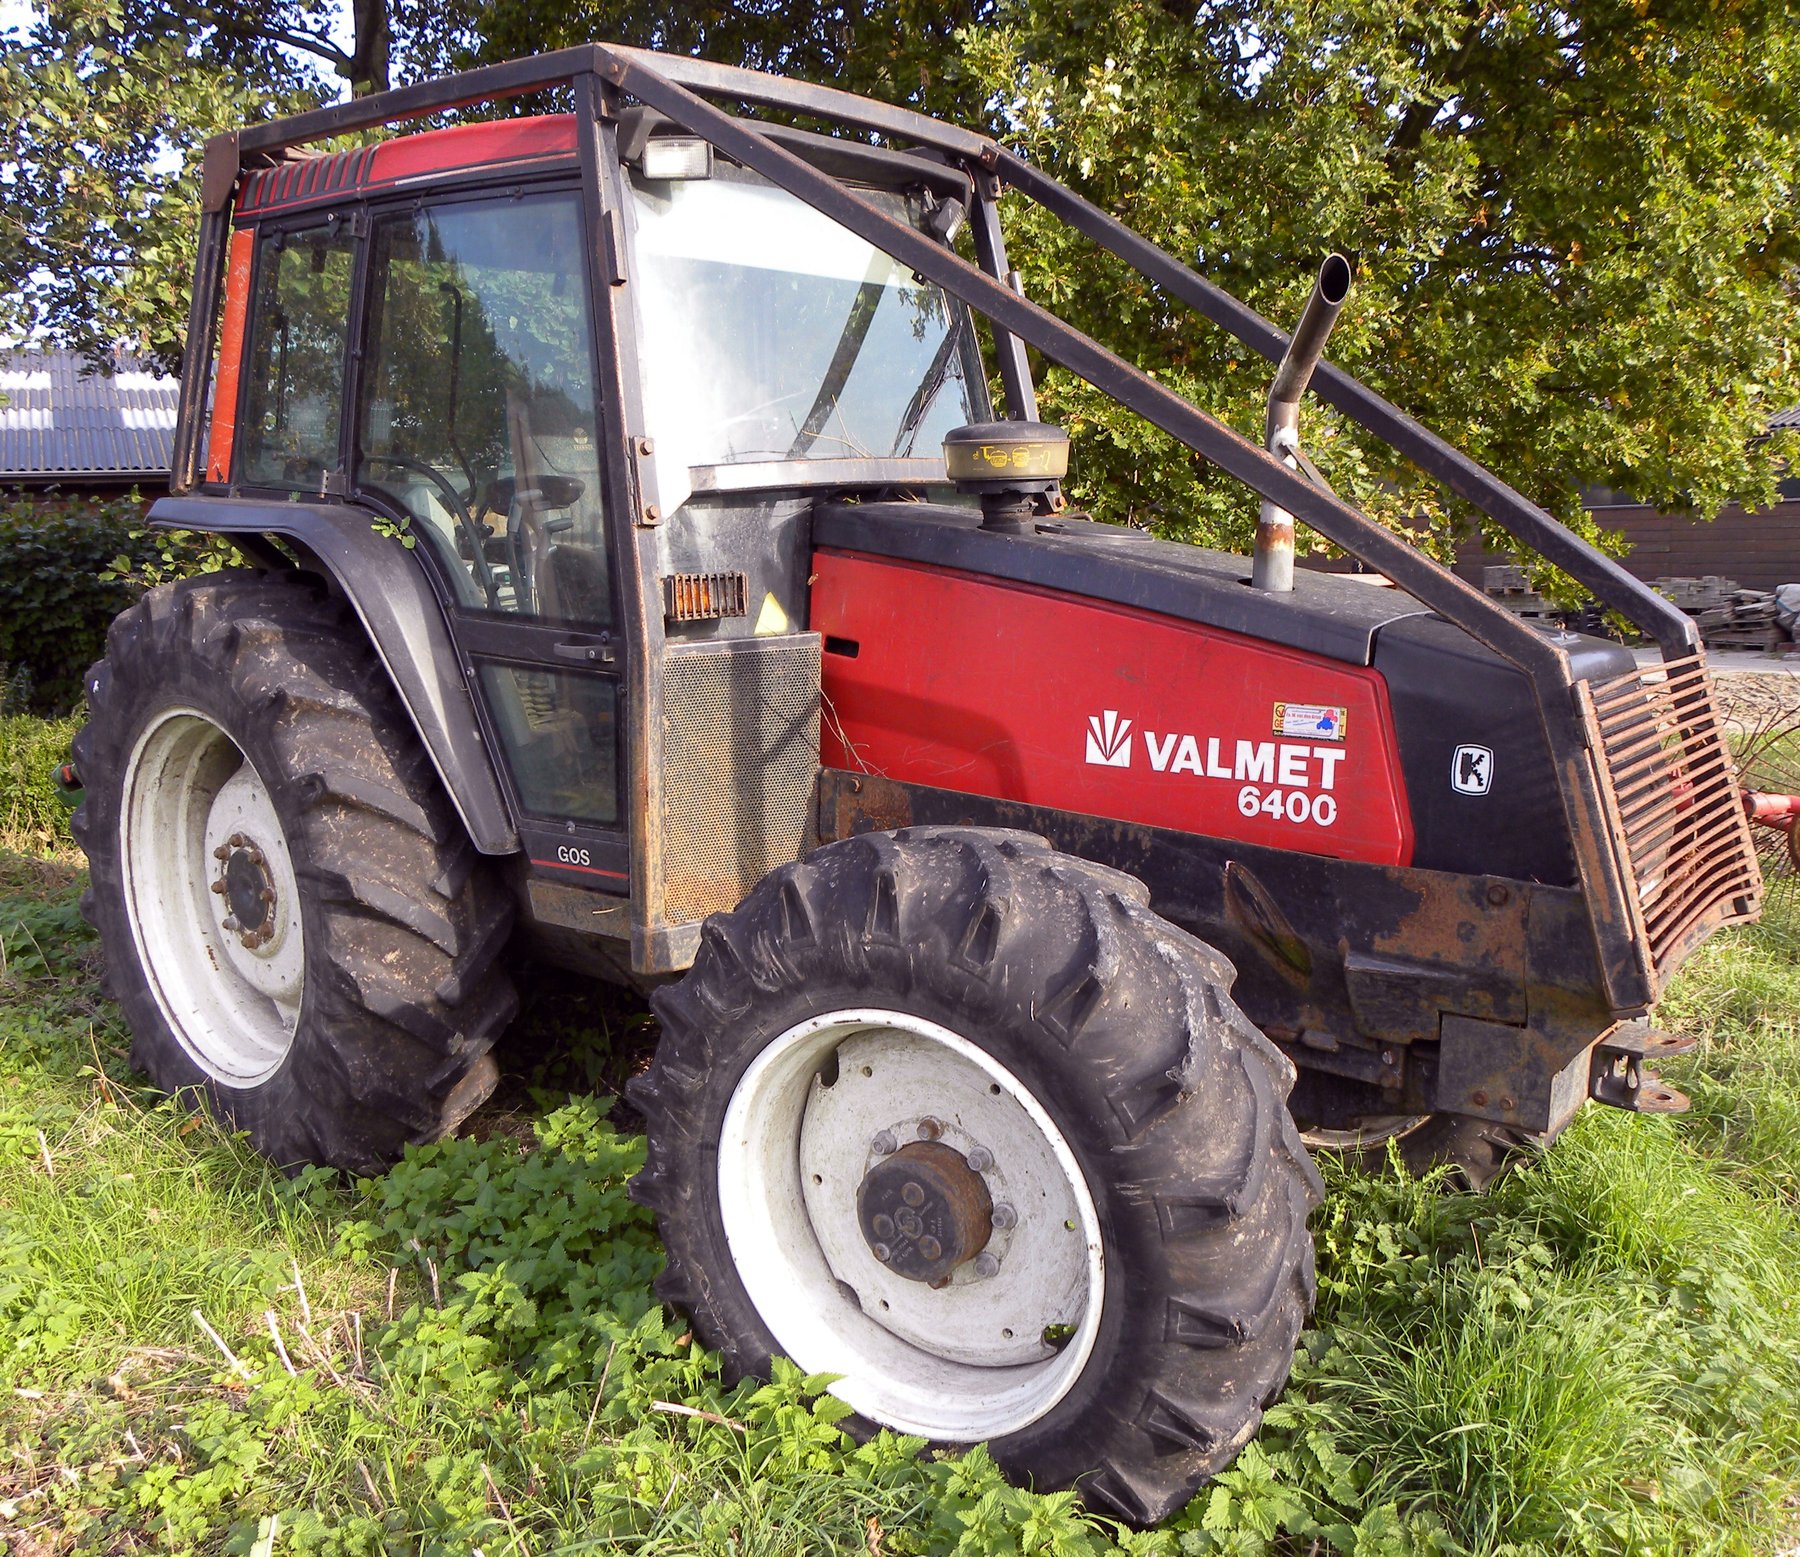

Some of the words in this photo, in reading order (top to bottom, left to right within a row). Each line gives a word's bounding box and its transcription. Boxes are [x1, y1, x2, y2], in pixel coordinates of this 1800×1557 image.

[1143, 730, 1346, 790] VALMET
[1237, 785, 1338, 827] 6400
[557, 845, 591, 866] GOS
